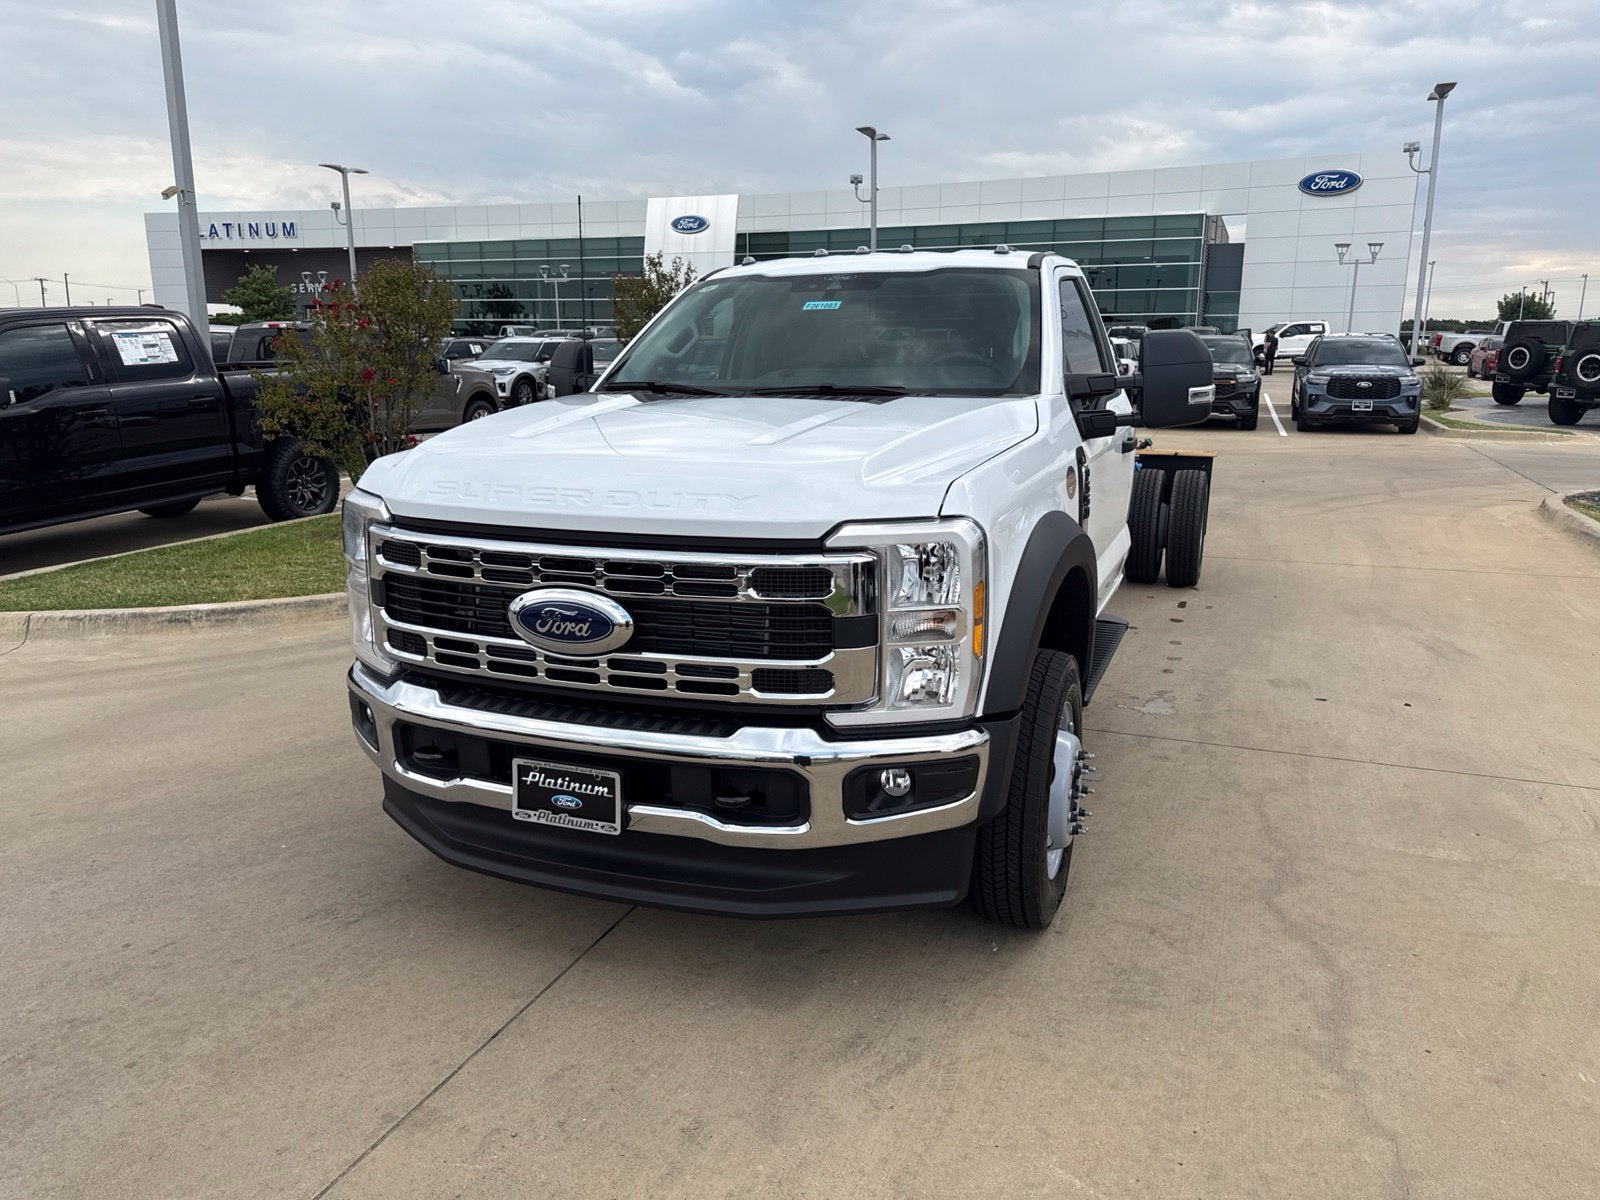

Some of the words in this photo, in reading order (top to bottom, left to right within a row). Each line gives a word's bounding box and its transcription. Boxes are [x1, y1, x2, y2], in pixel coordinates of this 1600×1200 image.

[1310, 174, 1348, 190] Ford
[179, 222, 297, 238] ATINUM
[677, 218, 699, 229] Ford
[426, 479, 594, 507] SUPER
[603, 489, 760, 513] DUTY
[536, 607, 592, 638] Ford
[521, 771, 614, 798] Platinum
[557, 797, 576, 808] Ford
[536, 809, 599, 830] Platinum
